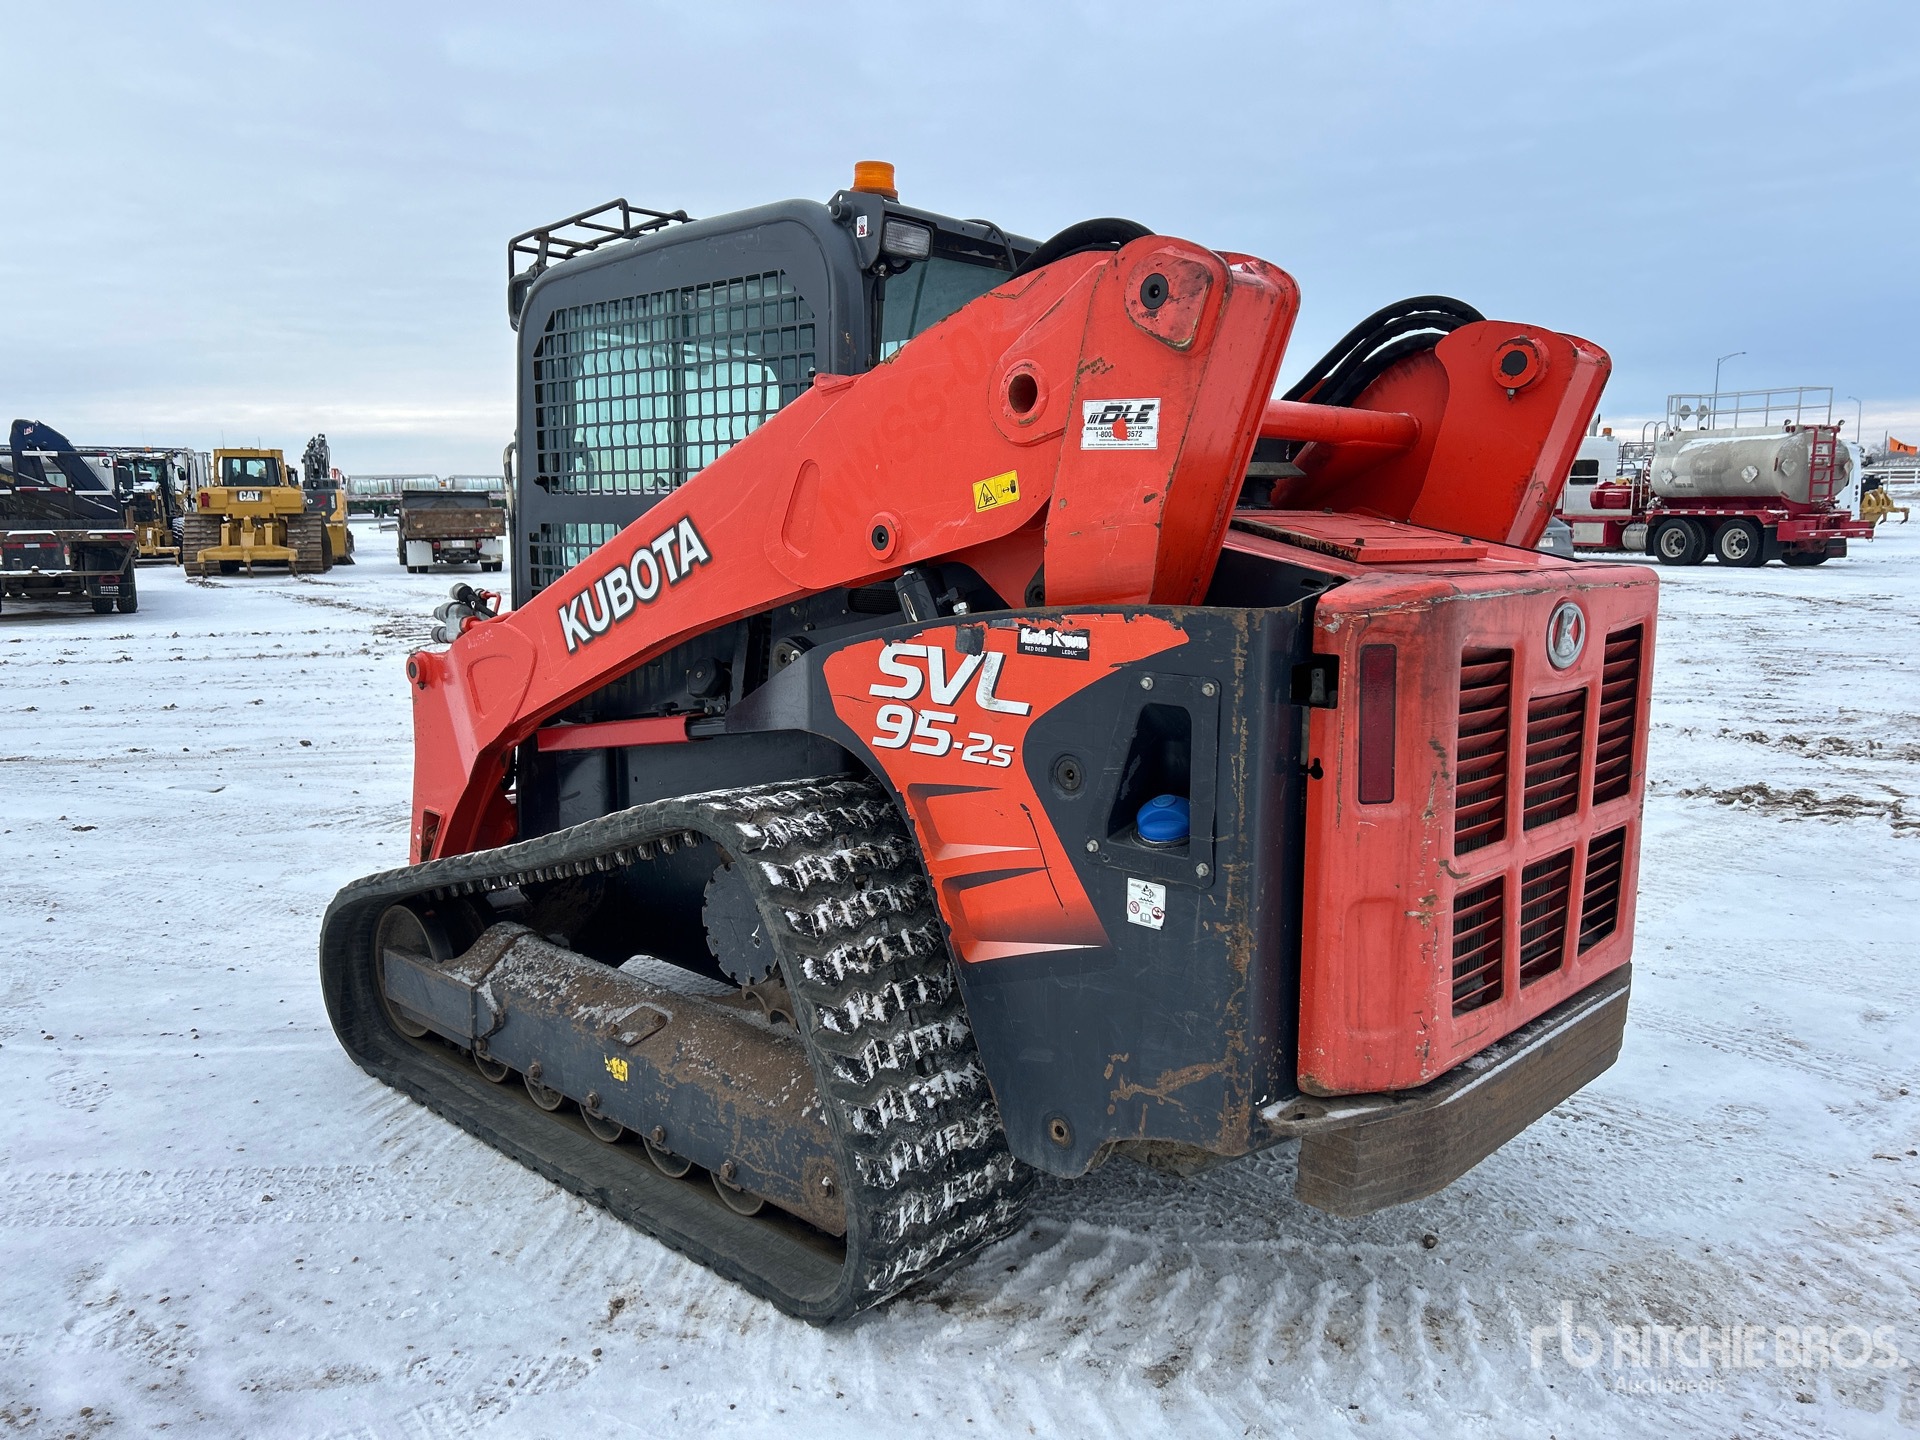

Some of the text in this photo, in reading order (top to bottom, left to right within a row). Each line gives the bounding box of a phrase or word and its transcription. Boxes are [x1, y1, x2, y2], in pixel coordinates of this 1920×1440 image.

[239, 490, 261, 502] CAT
[558, 517, 711, 653] KUBOTA
[868, 643, 1032, 716] SVL
